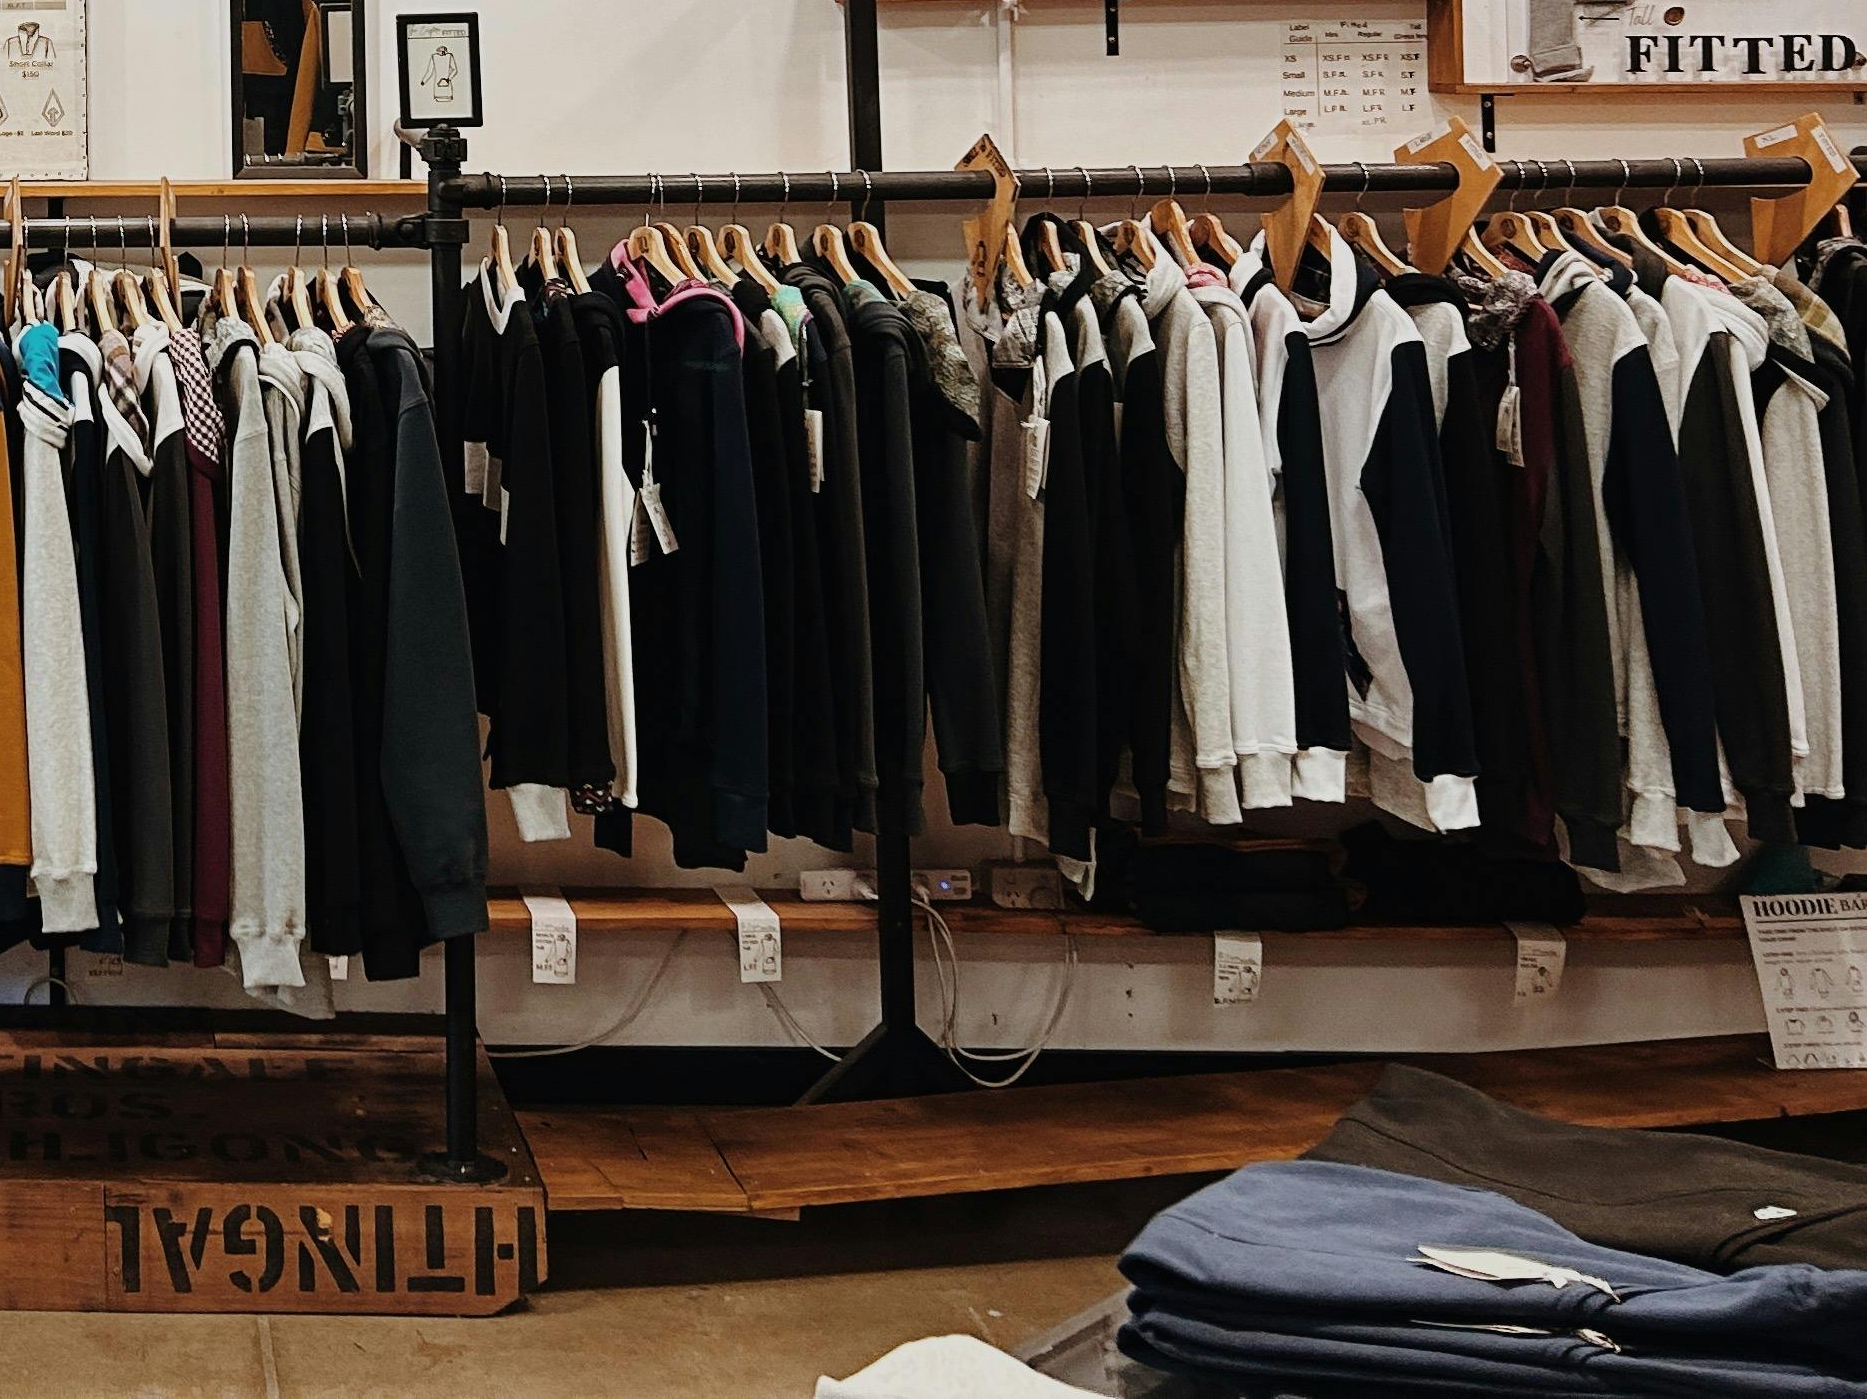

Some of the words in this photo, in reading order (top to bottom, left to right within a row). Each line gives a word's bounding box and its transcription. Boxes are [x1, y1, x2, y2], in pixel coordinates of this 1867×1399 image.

[1627, 4, 1655, 26] Tall
[1624, 34, 1857, 75] FITTED
[1283, 71, 1306, 79] Small
[1284, 108, 1307, 117] Large
[1752, 898, 1838, 917] HOODIE
